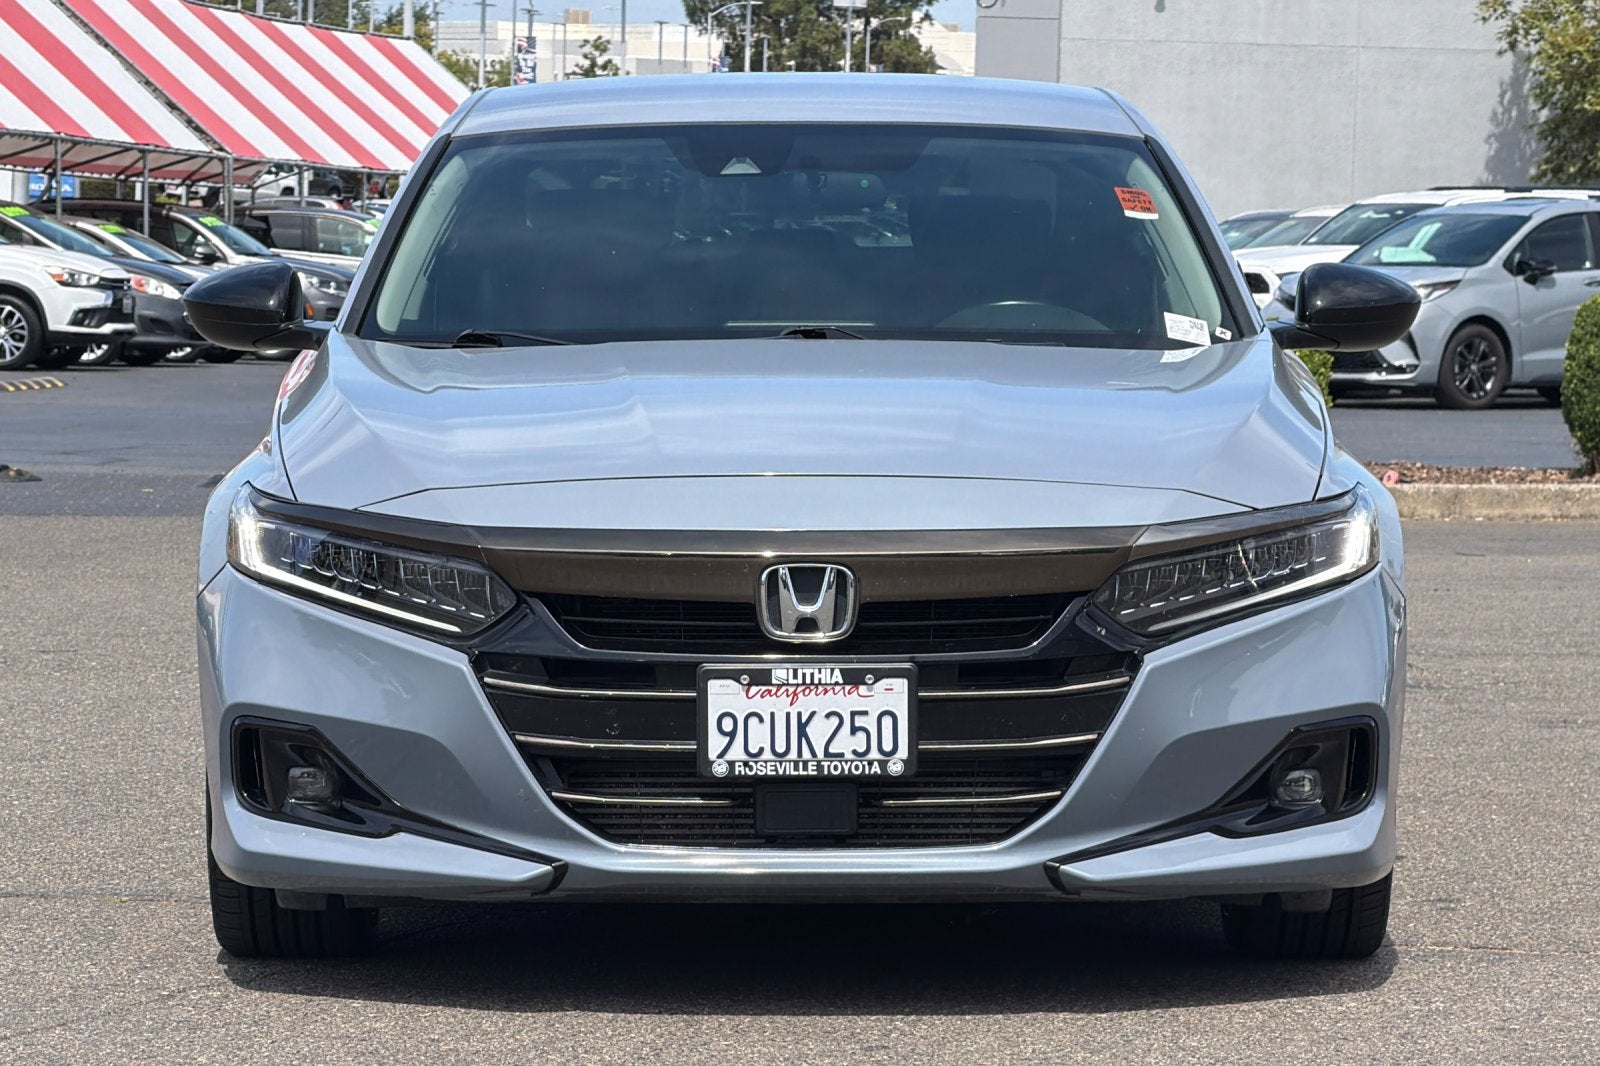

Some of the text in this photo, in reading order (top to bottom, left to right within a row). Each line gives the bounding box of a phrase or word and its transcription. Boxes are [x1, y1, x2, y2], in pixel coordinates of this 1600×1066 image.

[788, 668, 844, 684] LITHIA
[745, 685, 875, 707] California
[716, 709, 899, 759] 9CUK250
[735, 761, 881, 775] ROSEVILLE TOYOTA
